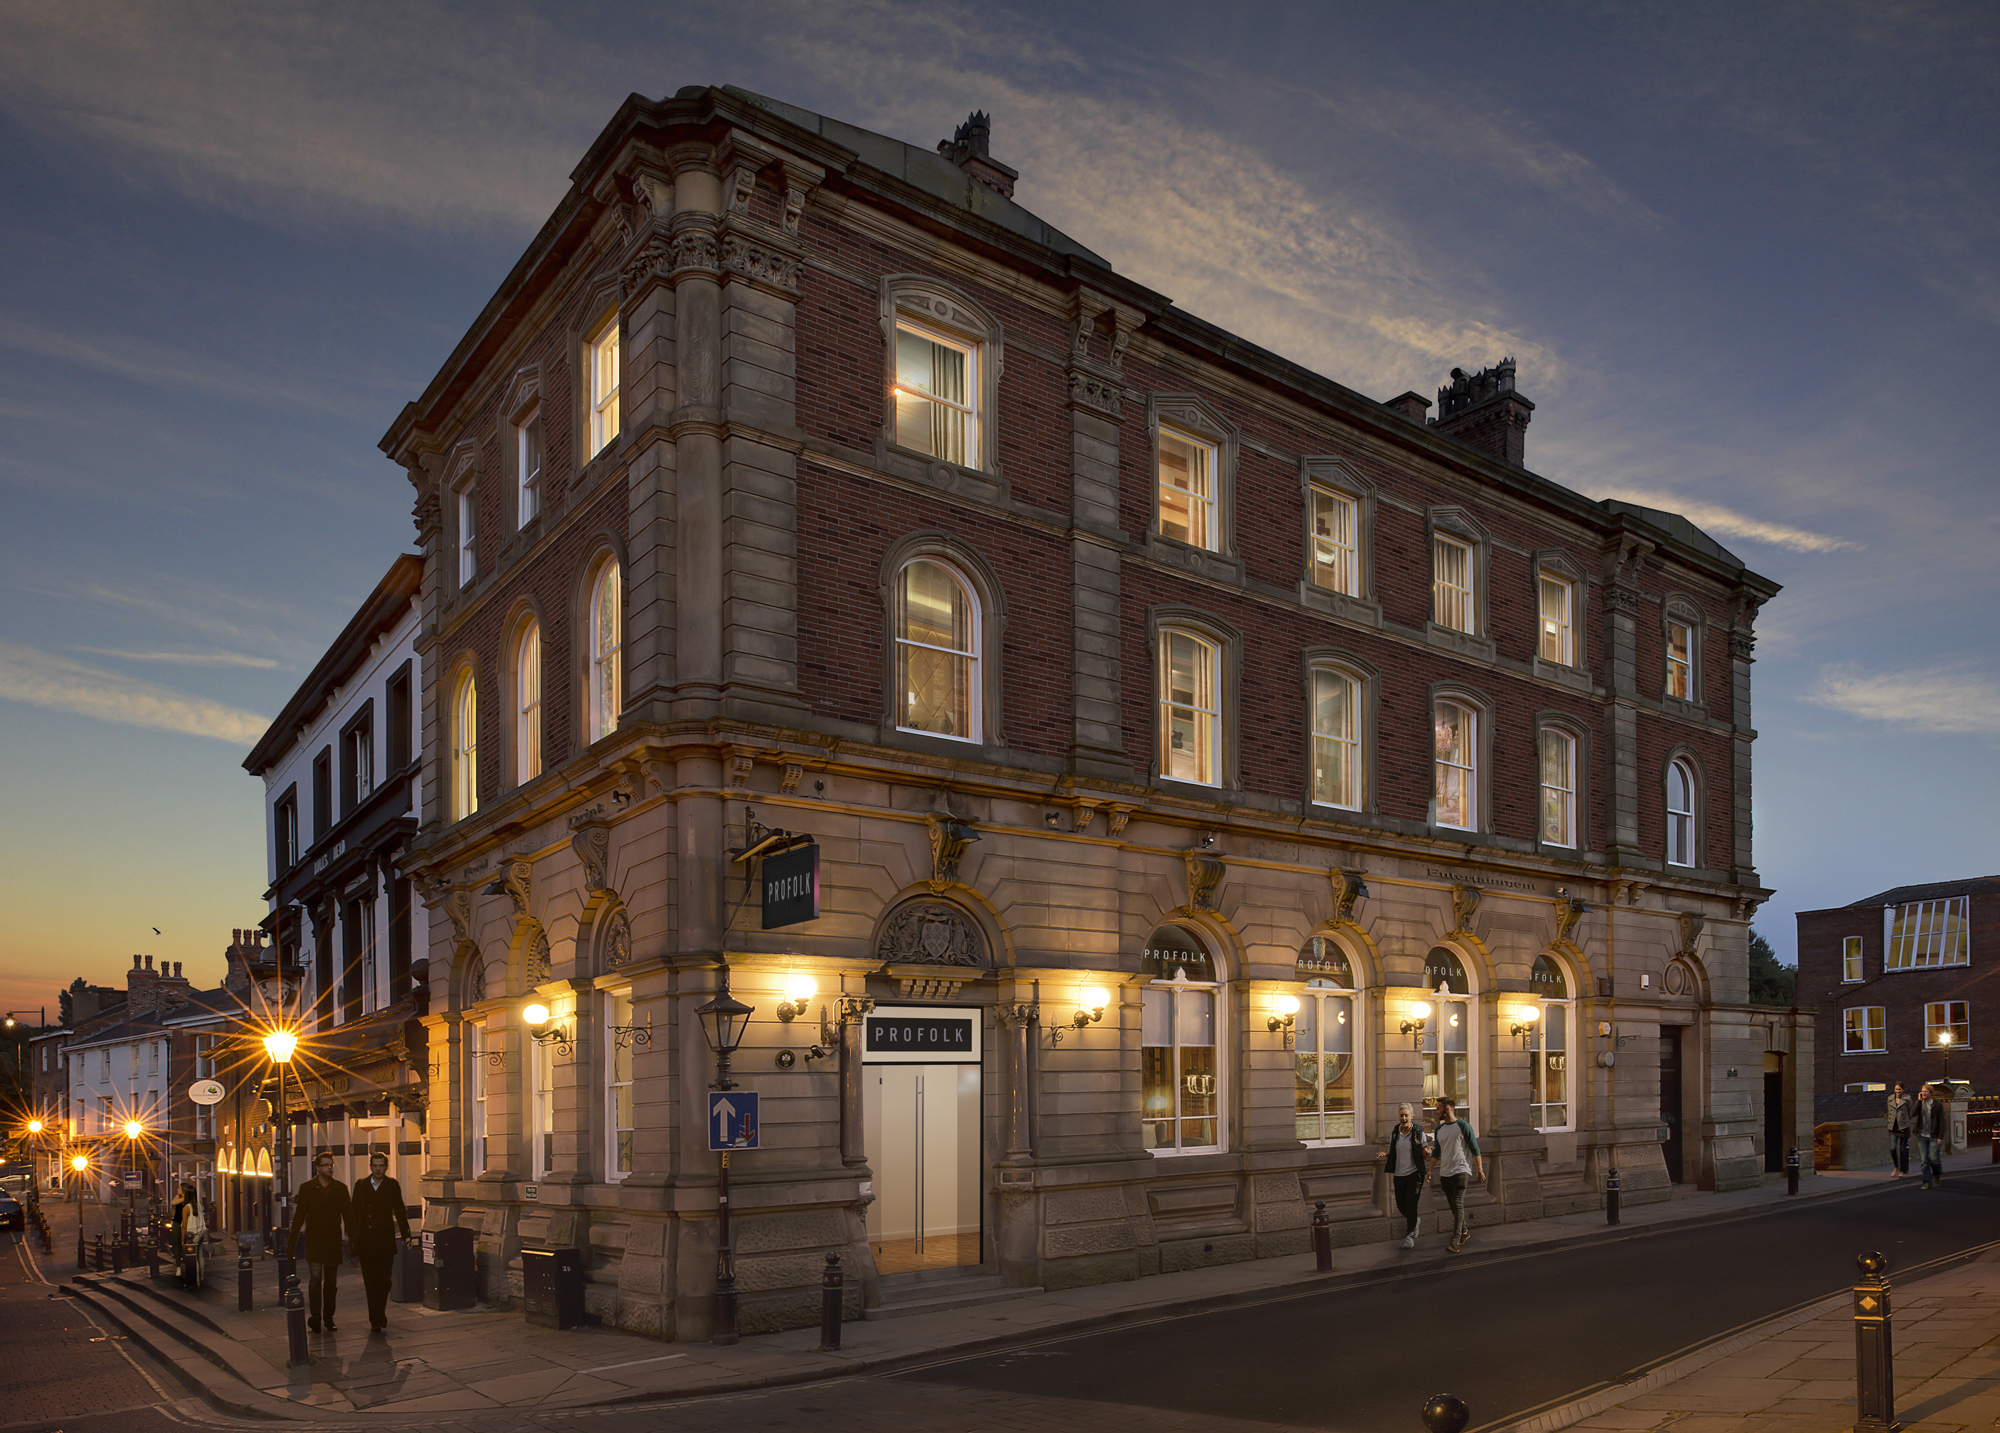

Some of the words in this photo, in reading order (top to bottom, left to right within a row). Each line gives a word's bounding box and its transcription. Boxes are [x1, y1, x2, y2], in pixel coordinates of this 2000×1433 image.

[1426, 867, 1537, 890] Entertainment
[768, 872, 811, 904] PROFOLK
[1144, 948, 1206, 963] PROFOLK
[1298, 959, 1348, 972] ROFOLK
[875, 1027, 963, 1042] PROFOLK
